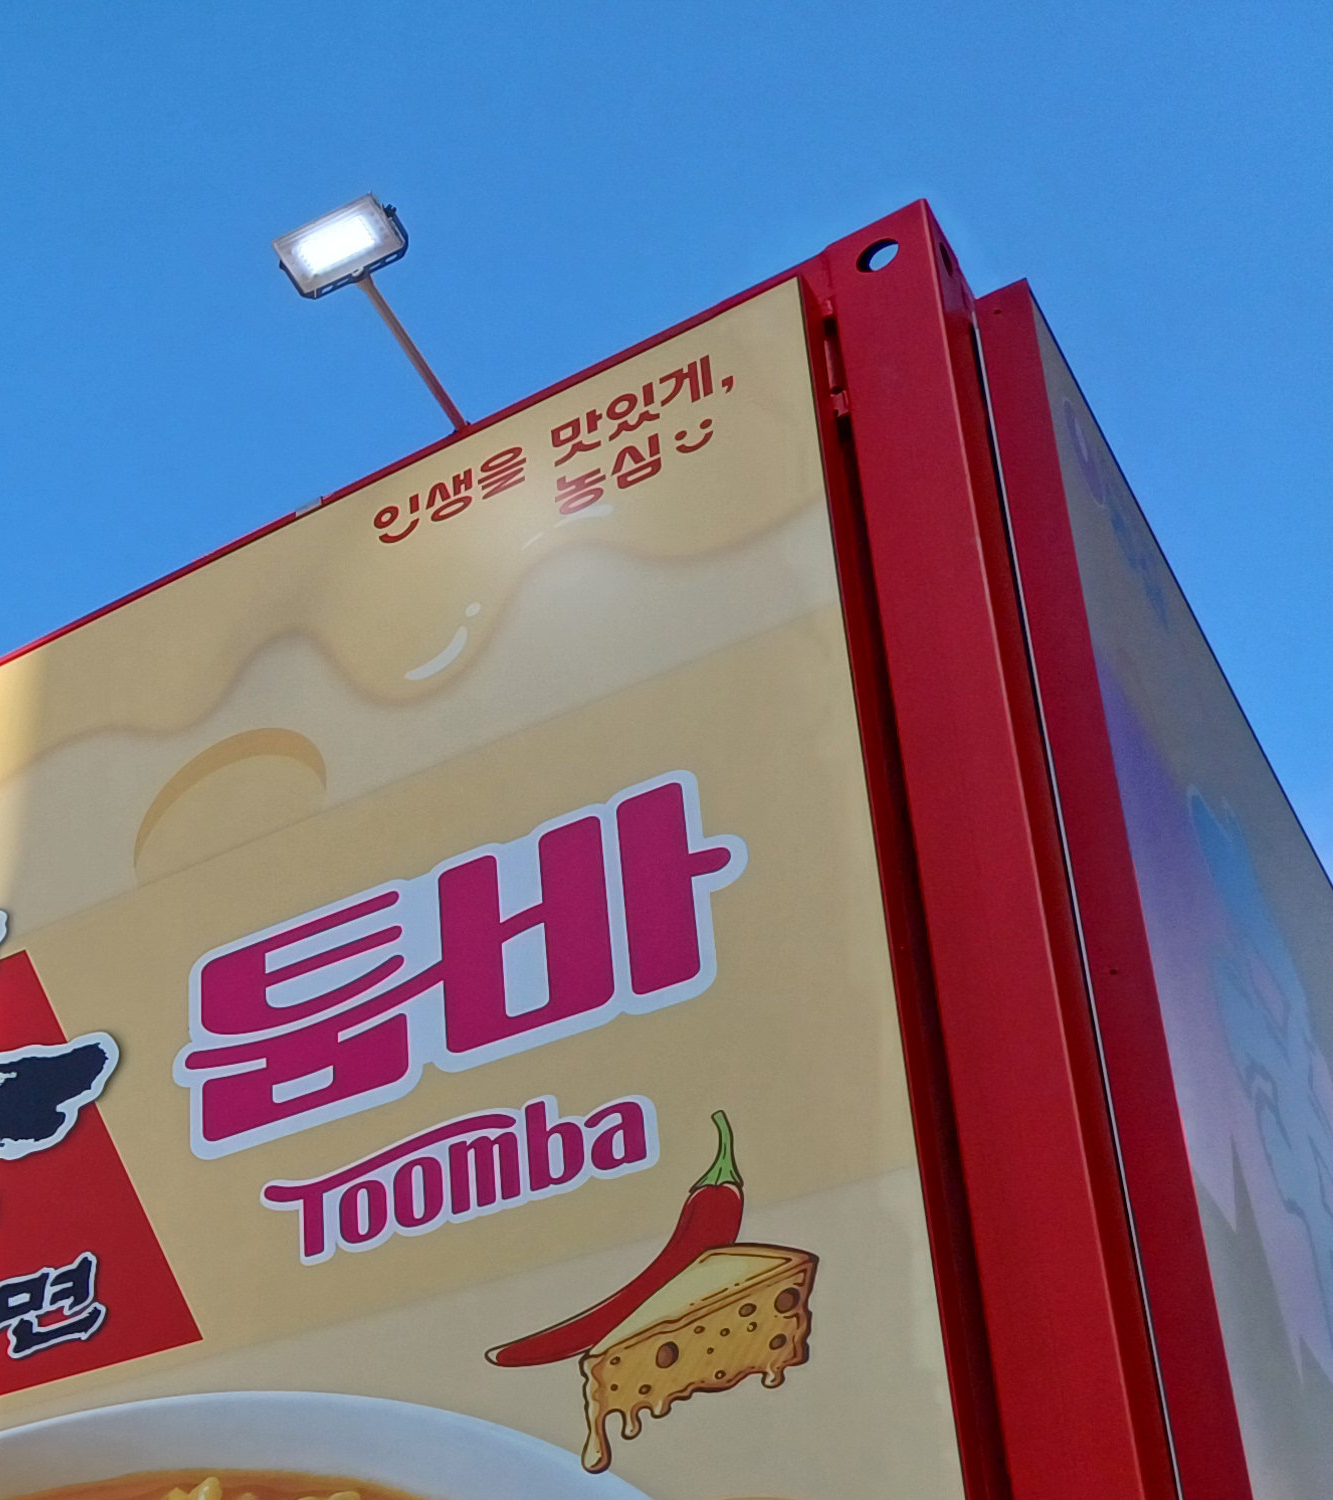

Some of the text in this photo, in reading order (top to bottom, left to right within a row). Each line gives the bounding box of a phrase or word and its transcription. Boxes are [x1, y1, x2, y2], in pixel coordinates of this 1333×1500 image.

[373, 355, 735, 543] 인생을 맛있게,
[555, 433, 661, 514] 농심
[178, 775, 738, 1150] 툼바
[264, 1096, 651, 1260] Toomba
